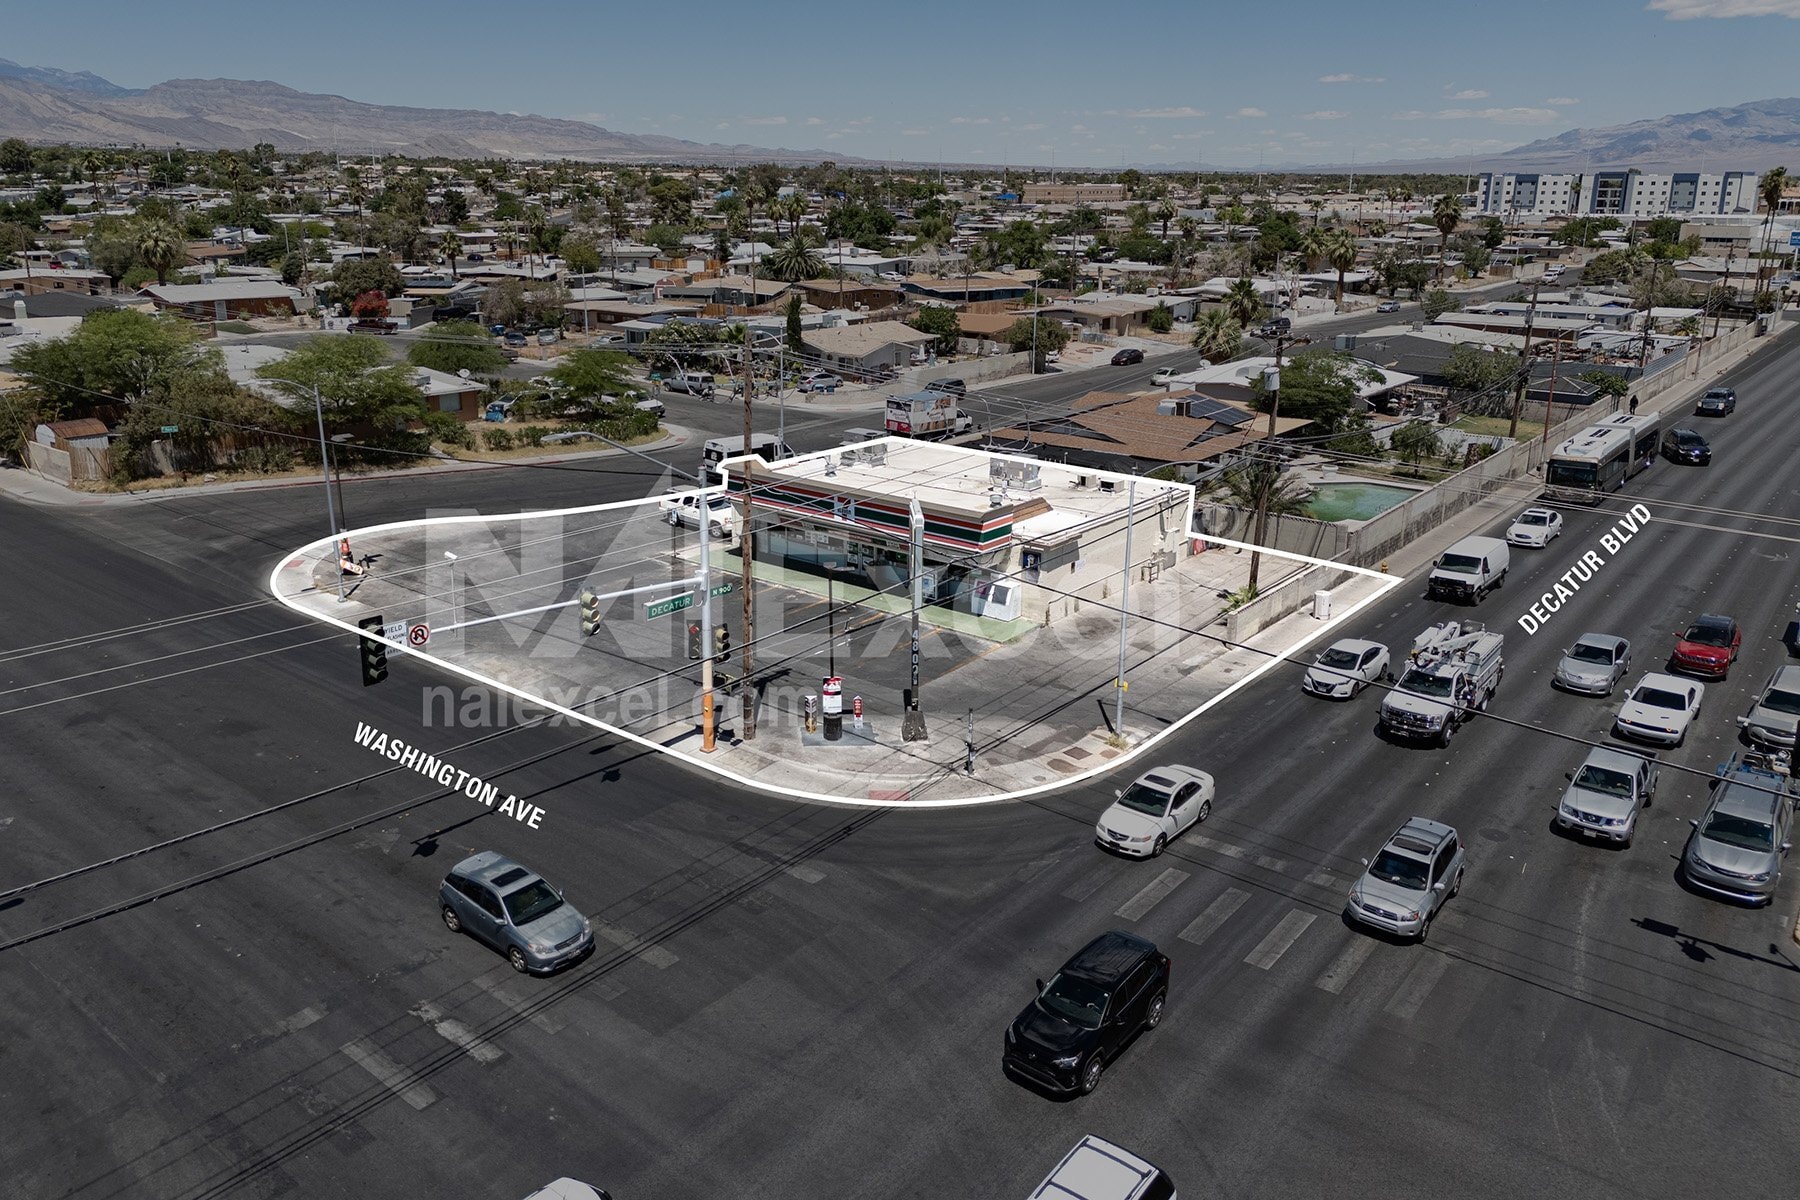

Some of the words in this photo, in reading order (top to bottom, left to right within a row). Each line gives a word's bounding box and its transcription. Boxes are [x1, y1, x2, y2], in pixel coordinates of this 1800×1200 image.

[718, 585, 732, 594] 900
[651, 597, 691, 616] DECATUR
[384, 624, 403, 633] YIELD
